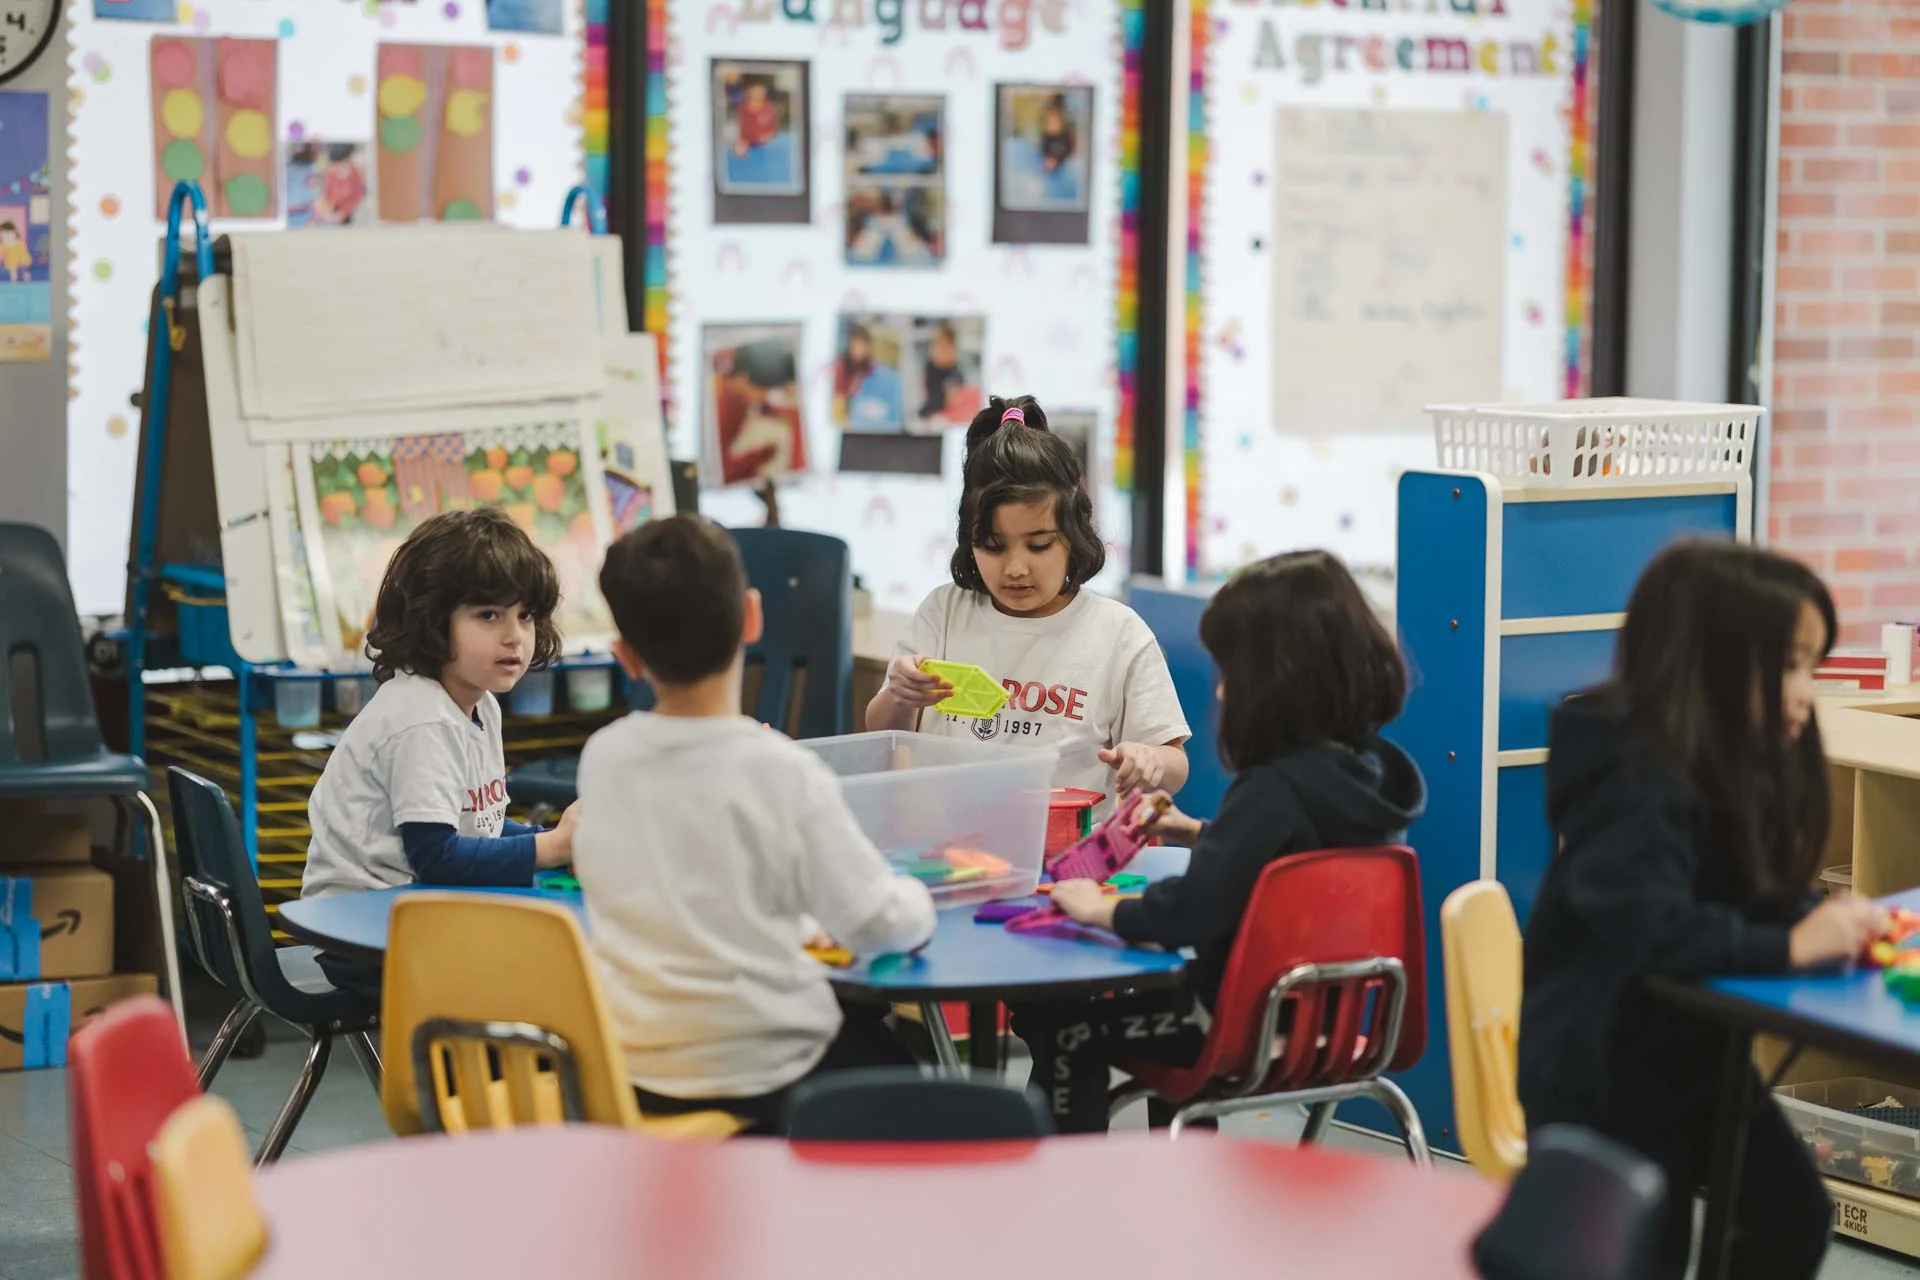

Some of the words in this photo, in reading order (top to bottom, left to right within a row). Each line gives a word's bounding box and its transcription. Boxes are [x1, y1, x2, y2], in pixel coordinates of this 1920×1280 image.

[6, 12, 25, 32] 4
[1252, 19, 1558, 85] Agreement
[1003, 719, 1043, 736] 1997
[1844, 1204, 1867, 1224] ECR
[1844, 1219, 1868, 1235] 4KIDS
